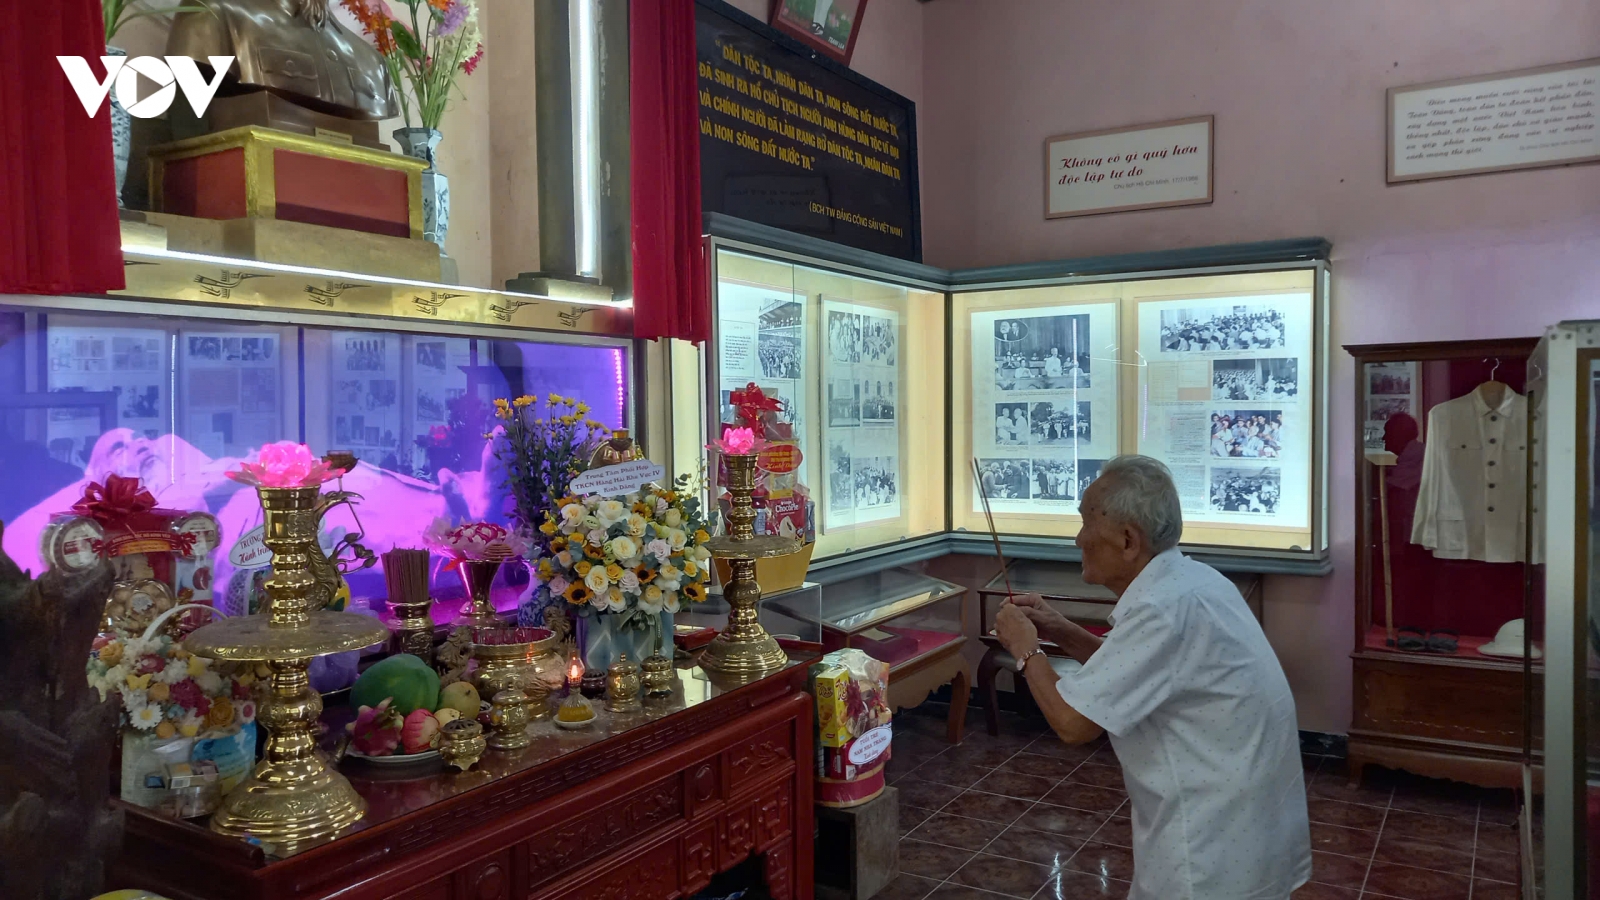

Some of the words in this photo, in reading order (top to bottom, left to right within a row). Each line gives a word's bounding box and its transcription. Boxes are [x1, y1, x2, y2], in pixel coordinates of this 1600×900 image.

[699, 61, 712, 80] ĐÃ
[714, 68, 735, 90] SINH
[737, 77, 749, 95] RA
[750, 80, 762, 101] HỒ
[763, 89, 780, 109] CHỦ
[781, 97, 799, 117] TỊCH
[799, 105, 822, 127] NGƯỜI
[823, 116, 837, 133] ANH
[838, 121, 856, 141] HÙNG
[857, 130, 869, 147] DÂN
[870, 135, 882, 153] TỘC
[882, 141, 889, 155] VĨ
[743, 54, 760, 75] TỘC
[798, 81, 813, 100] DÂN
[842, 101, 859, 120] SÔNG
[860, 109, 872, 126] ĐẤT
[873, 117, 889, 134] NƯỚC
[699, 87, 711, 108] VÀ
[713, 96, 740, 119] CHÍNH
[741, 109, 766, 129] NGƯỜI
[767, 117, 779, 133] ĐÃ
[779, 119, 795, 139] LÀM
[796, 128, 816, 146] RẠNG
[827, 141, 841, 158] DÂN
[841, 145, 854, 163] TỘC
[881, 161, 893, 177] DÂN
[892, 166, 901, 181] TA
[699, 116, 712, 137] VÀ
[714, 123, 734, 144] NON
[736, 131, 760, 152] SÔNG
[761, 139, 777, 158] ĐẤT
[779, 146, 800, 166] NƯỚC
[1058, 174, 1080, 187] độc
[1084, 172, 1105, 185] lập
[1110, 170, 1123, 181] tự
[1127, 166, 1143, 176] do
[1060, 157, 1103, 170] Không
[1107, 153, 1120, 164] có
[1143, 148, 1168, 161] quý
[1173, 145, 1198, 155] hơn
[826, 206, 835, 217] TW
[836, 208, 852, 223] ĐẢNG
[852, 214, 868, 227] CỘNG
[868, 217, 879, 230] SẢN
[878, 221, 890, 234] VIỆT
[575, 482, 594, 490] TKCN
